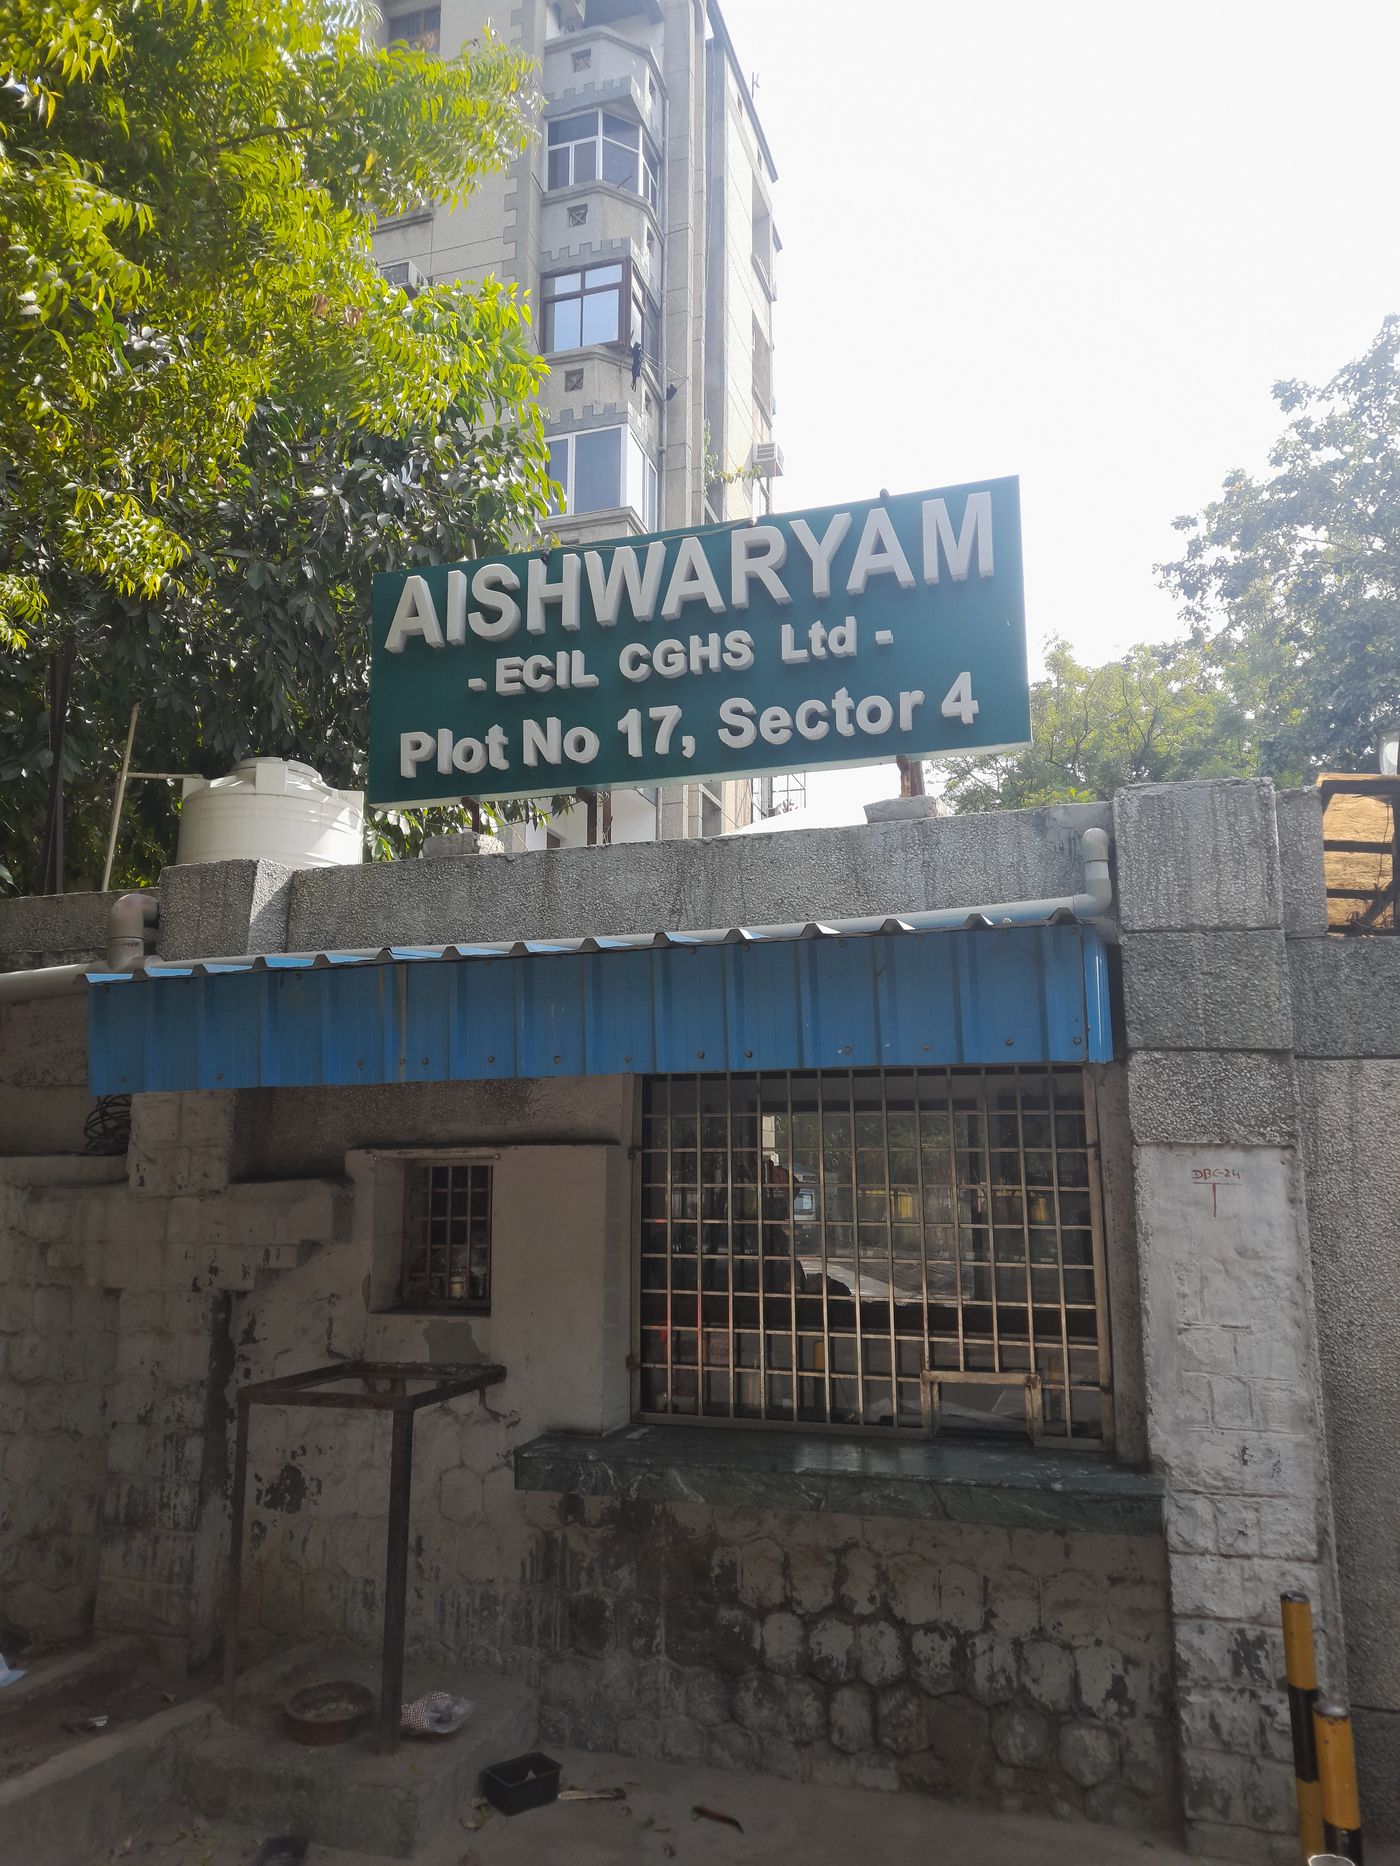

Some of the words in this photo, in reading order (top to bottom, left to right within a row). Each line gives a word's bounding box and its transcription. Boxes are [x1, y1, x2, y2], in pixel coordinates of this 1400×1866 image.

[384, 491, 995, 653] AISHWARYAM
[496, 650, 599, 696] ECIL
[619, 630, 754, 682] CGHS
[781, 616, 857, 664] Ltd
[400, 724, 510, 778] Plot
[523, 717, 600, 766] No
[617, 705, 696, 759] 17,
[717, 686, 925, 749] Sector
[941, 671, 979, 724] 4
